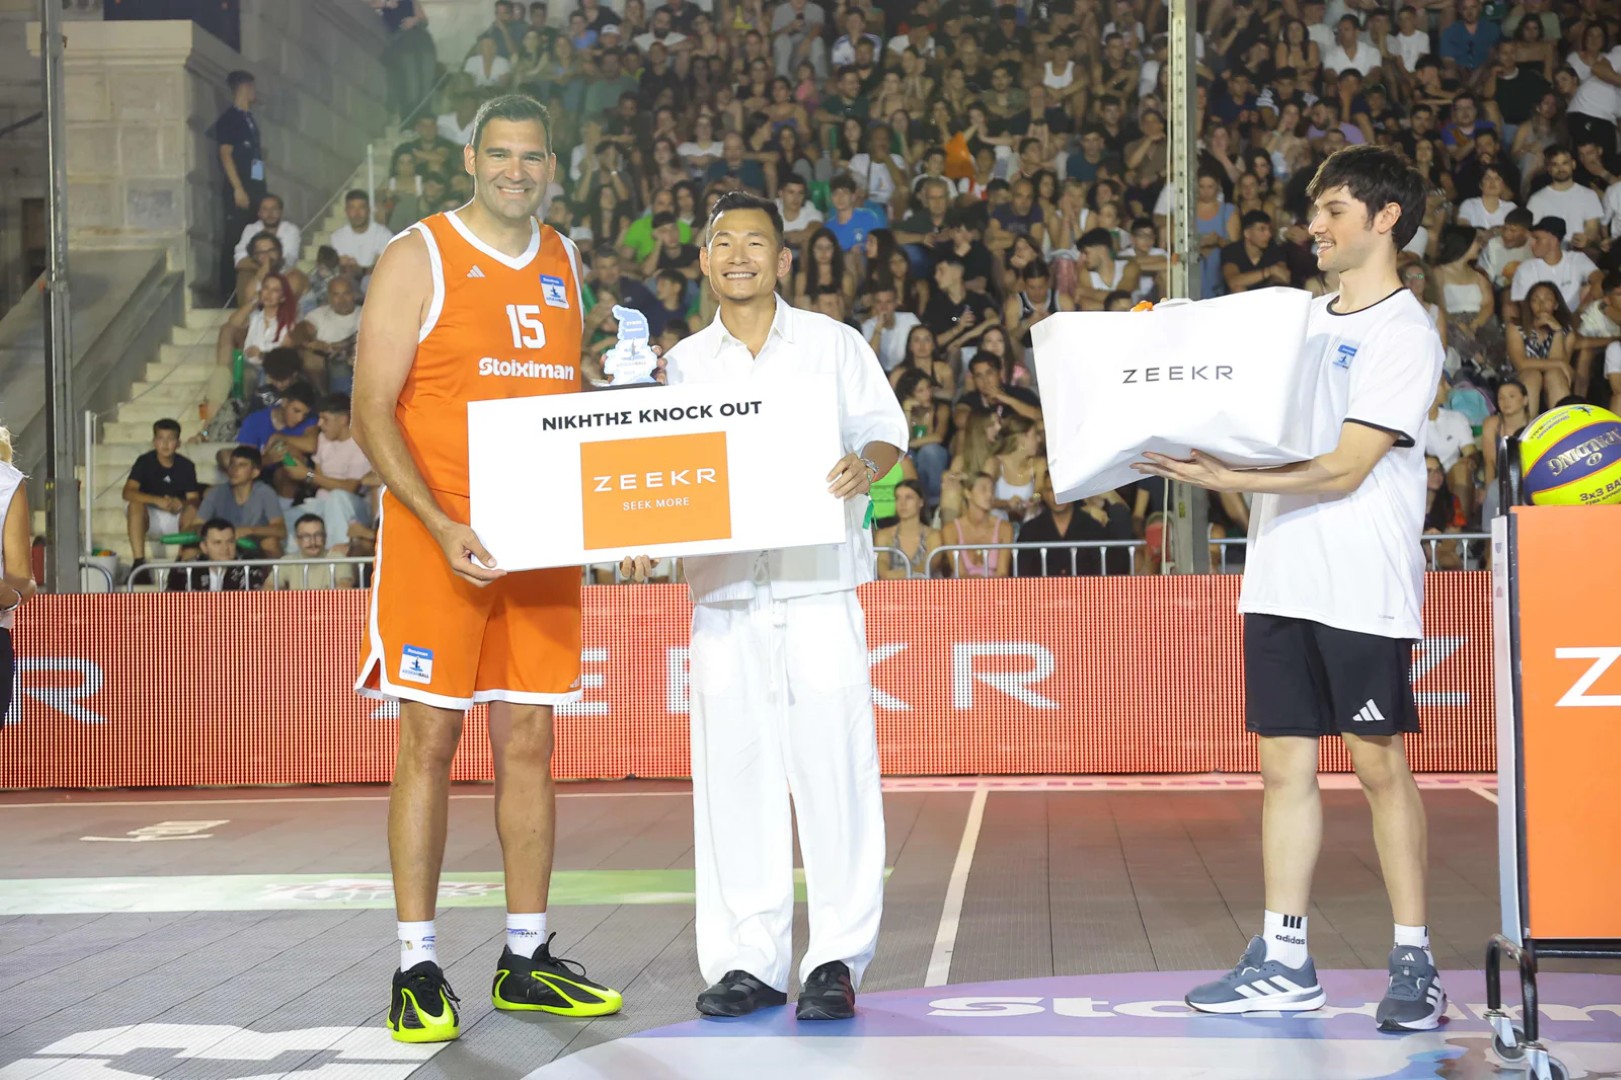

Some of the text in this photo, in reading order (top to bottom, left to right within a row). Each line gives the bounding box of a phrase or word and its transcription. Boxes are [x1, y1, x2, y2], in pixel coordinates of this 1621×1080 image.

[505, 304, 547, 349] 15
[478, 357, 575, 381] Stoiximan
[1122, 365, 1233, 384] ZEEKR
[542, 400, 763, 431] ΝΙΚΗΤΗΣ KNOCK OUT
[593, 467, 717, 493] ZEEKR
[1605, 476, 1621, 493] BA
[623, 497, 690, 511] SEEK MORE
[1275, 934, 1306, 945] adidas
